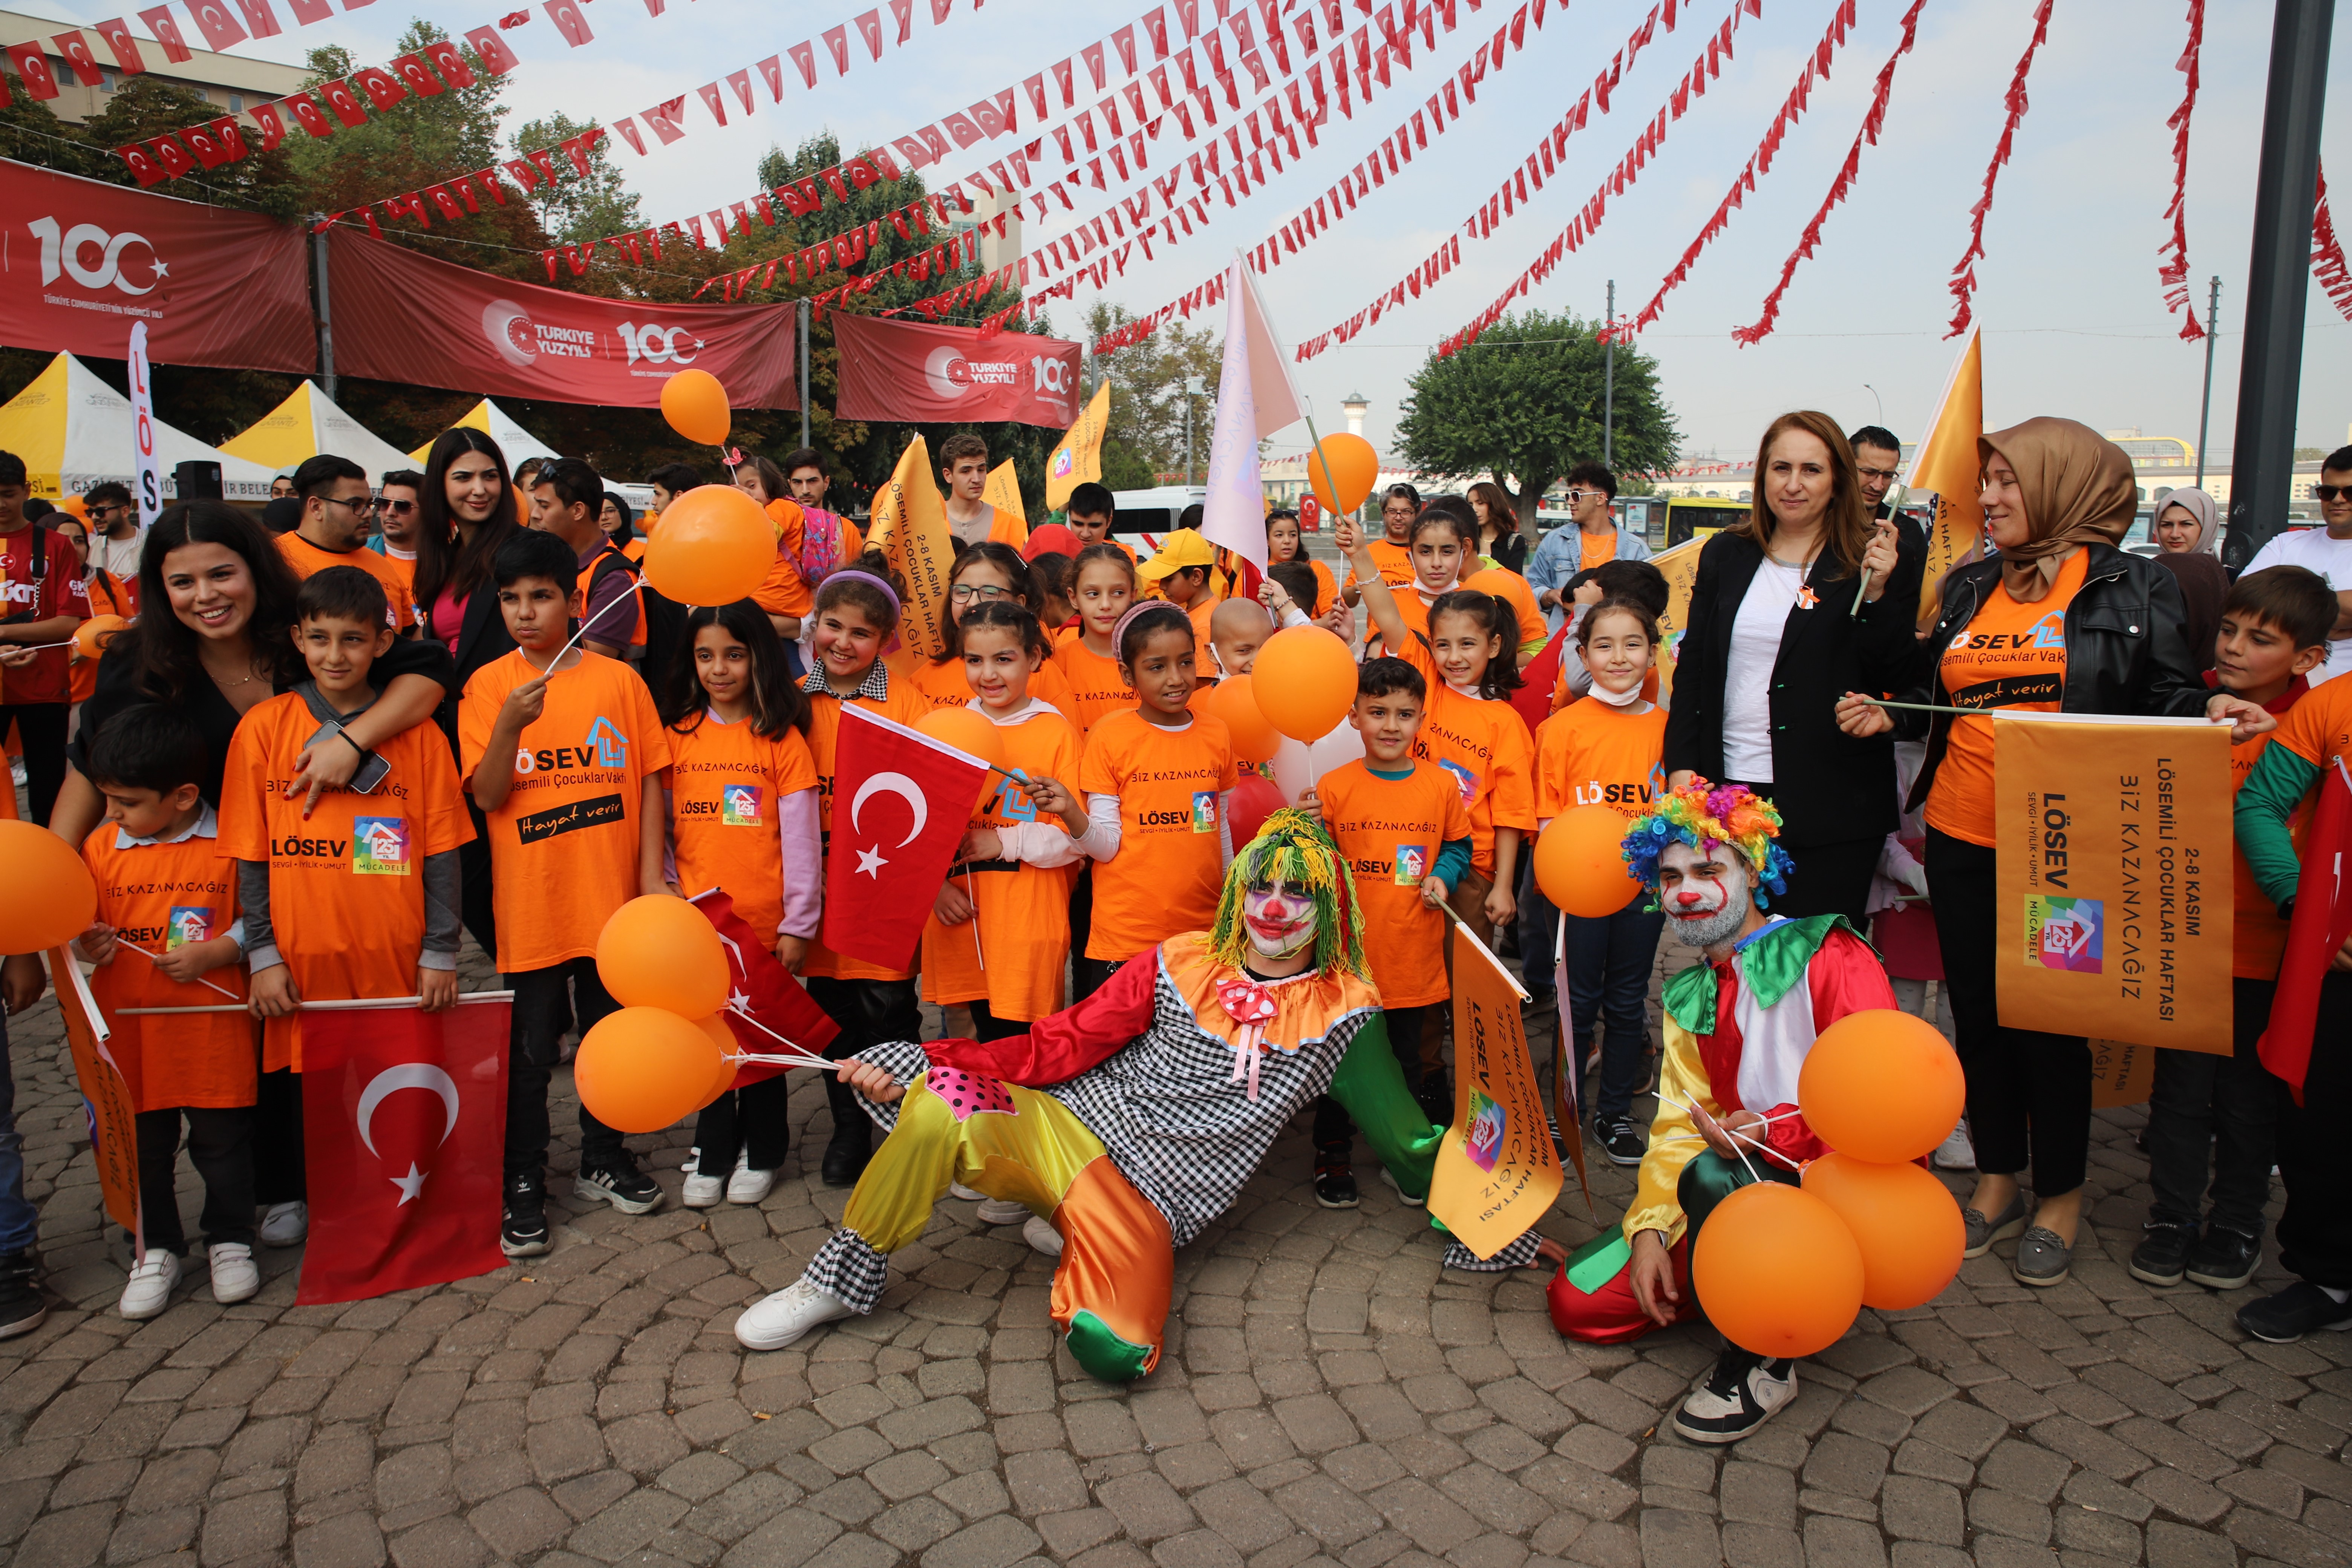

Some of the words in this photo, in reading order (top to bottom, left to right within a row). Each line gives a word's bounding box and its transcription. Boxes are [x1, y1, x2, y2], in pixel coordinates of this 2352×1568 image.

[28, 216, 157, 295] 100
[534, 324, 595, 345] TÜRKİYE
[617, 321, 697, 366] 100
[968, 362, 1017, 374] TÜRKİYE
[1031, 355, 1070, 395] 100
[133, 351, 156, 511] LÖS
[890, 476, 912, 536] LÖSEMİLİ
[903, 539, 929, 609] ÇOCUKLAR
[923, 611, 943, 655] HAFTA
[917, 534, 929, 554] 2-8
[923, 557, 942, 597] KASIM
[1948, 631, 2035, 650] ÖSEV
[1978, 651, 2036, 665] Çocuklar
[2040, 651, 2066, 664] Vak
[1955, 681, 2002, 709] Hayat
[2011, 683, 2055, 696] verir
[515, 746, 594, 774] ÖSEV
[675, 764, 688, 775] BİZ
[266, 780, 291, 792] BİZ
[554, 773, 604, 789] Çocuklar
[606, 772, 626, 785] Vakfı
[1132, 772, 1149, 783] BİZ
[739, 800, 750, 812] 25
[1575, 781, 1652, 805] LÖSEV
[2028, 791, 2037, 819] SEVGİ
[2120, 775, 2139, 812] BİZ
[2157, 758, 2174, 841] LÖSEMİLİ
[522, 805, 579, 836] Hayat
[586, 802, 620, 818] verir
[681, 800, 719, 815] LÖSEV
[1139, 810, 1190, 825] LÖSEV
[1339, 822, 1357, 832] BİZ
[1361, 821, 1436, 833] KAZANACAĞIZ
[2029, 827, 2038, 854] İYİLİK
[271, 835, 347, 858] LÖSEV
[377, 839, 394, 854] 25
[2043, 793, 2072, 890] LÖSEV
[299, 861, 318, 869] İYİLİK
[358, 863, 406, 872] MÜCADELE
[2030, 860, 2038, 887] UMUT
[2185, 847, 2200, 875] 2-8
[127, 881, 228, 895] KAZANACAĞIZ
[2154, 846, 2174, 943] ÇOCUKLAR
[2121, 824, 2145, 1000] KAZANACAĞIZ
[2185, 880, 2201, 937] KASIM
[116, 926, 164, 943] ÖSEV
[2029, 900, 2038, 961] MÜCADELE
[2050, 924, 2073, 949] 25
[2158, 948, 2174, 1022] HAFTASI
[1495, 1007, 1507, 1043] BİZ
[1472, 1000, 1490, 1091] LÖSEV
[1505, 1003, 1525, 1080] LÖSEMİLİ
[2114, 1046, 2136, 1090] HAFTASI
[1462, 1092, 1476, 1146] MÜCADELE
[1480, 1049, 1523, 1199] KAZANACAĞIZ
[1519, 1081, 1537, 1167] ÇOCUKLAR
[1535, 1116, 1549, 1168] KASIM
[1479, 1168, 1533, 1222] HAFTASI
